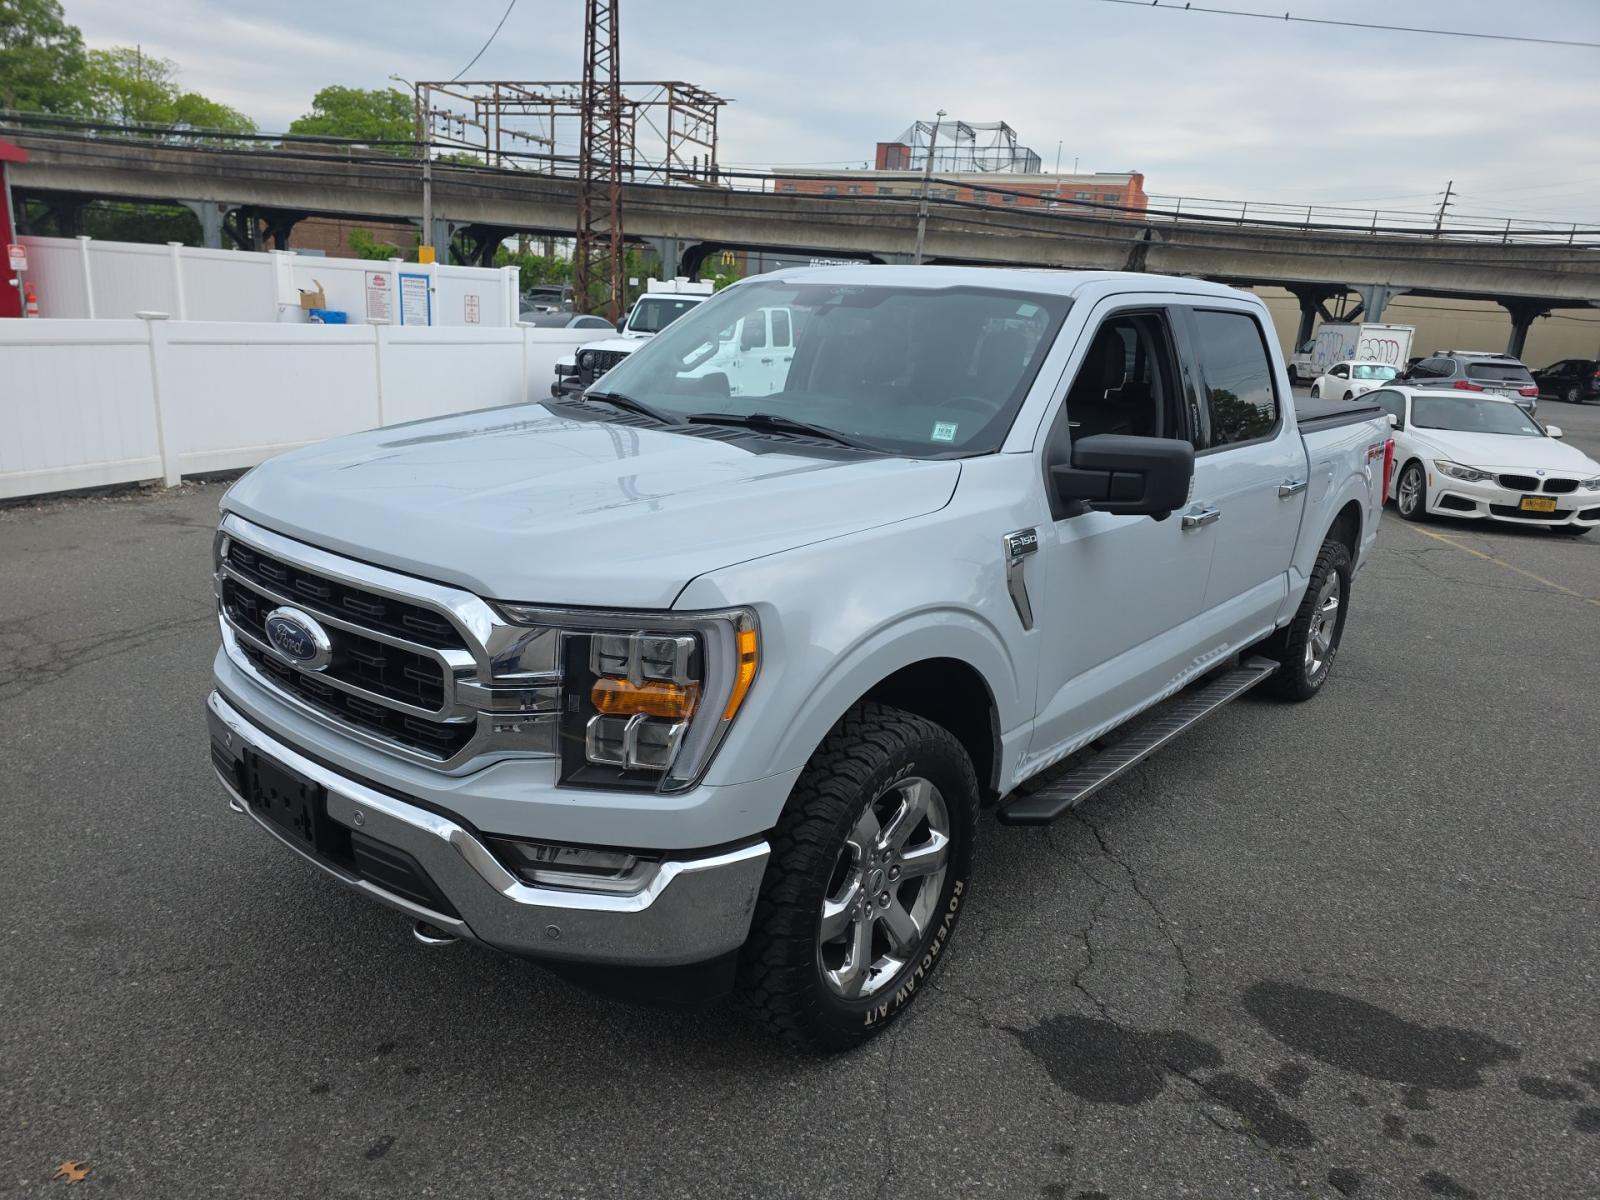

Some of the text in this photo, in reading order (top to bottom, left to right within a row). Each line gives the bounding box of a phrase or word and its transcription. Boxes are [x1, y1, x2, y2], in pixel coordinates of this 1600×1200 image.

[275, 623, 305, 655] Ford
[864, 880, 965, 1026] ROVERCLAW A/T
